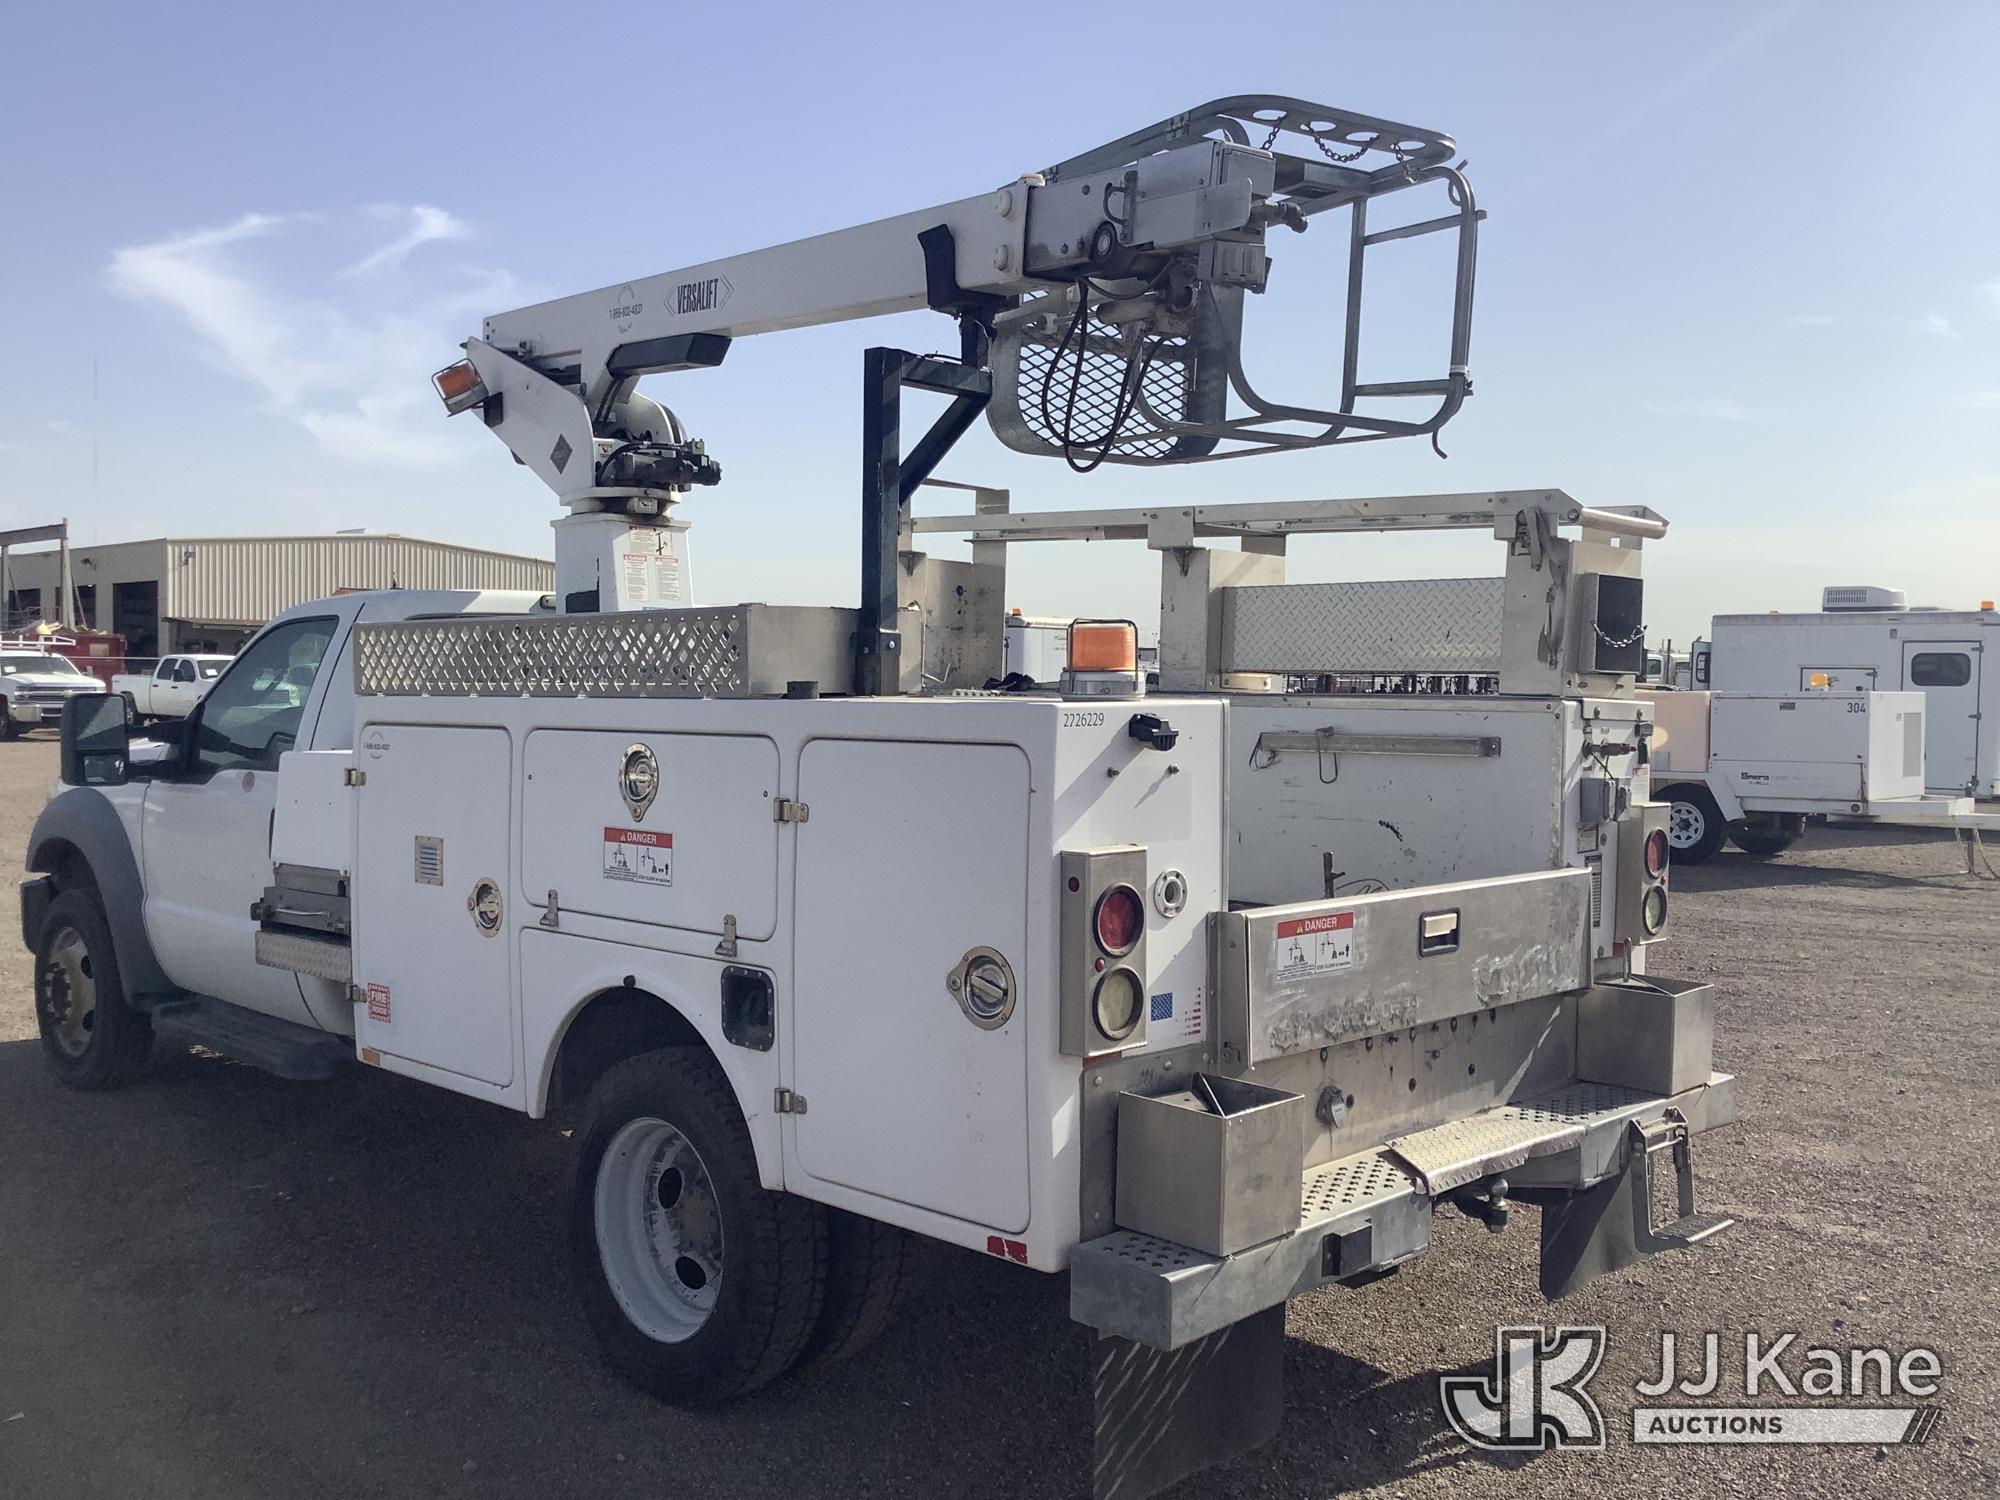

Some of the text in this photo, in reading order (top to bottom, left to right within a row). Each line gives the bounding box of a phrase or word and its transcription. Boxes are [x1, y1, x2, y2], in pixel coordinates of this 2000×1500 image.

[677, 278, 719, 315] VERSALIFT
[1847, 702, 1866, 713] 304
[627, 832, 657, 844] DANGER
[1304, 917, 1338, 931] DANGER
